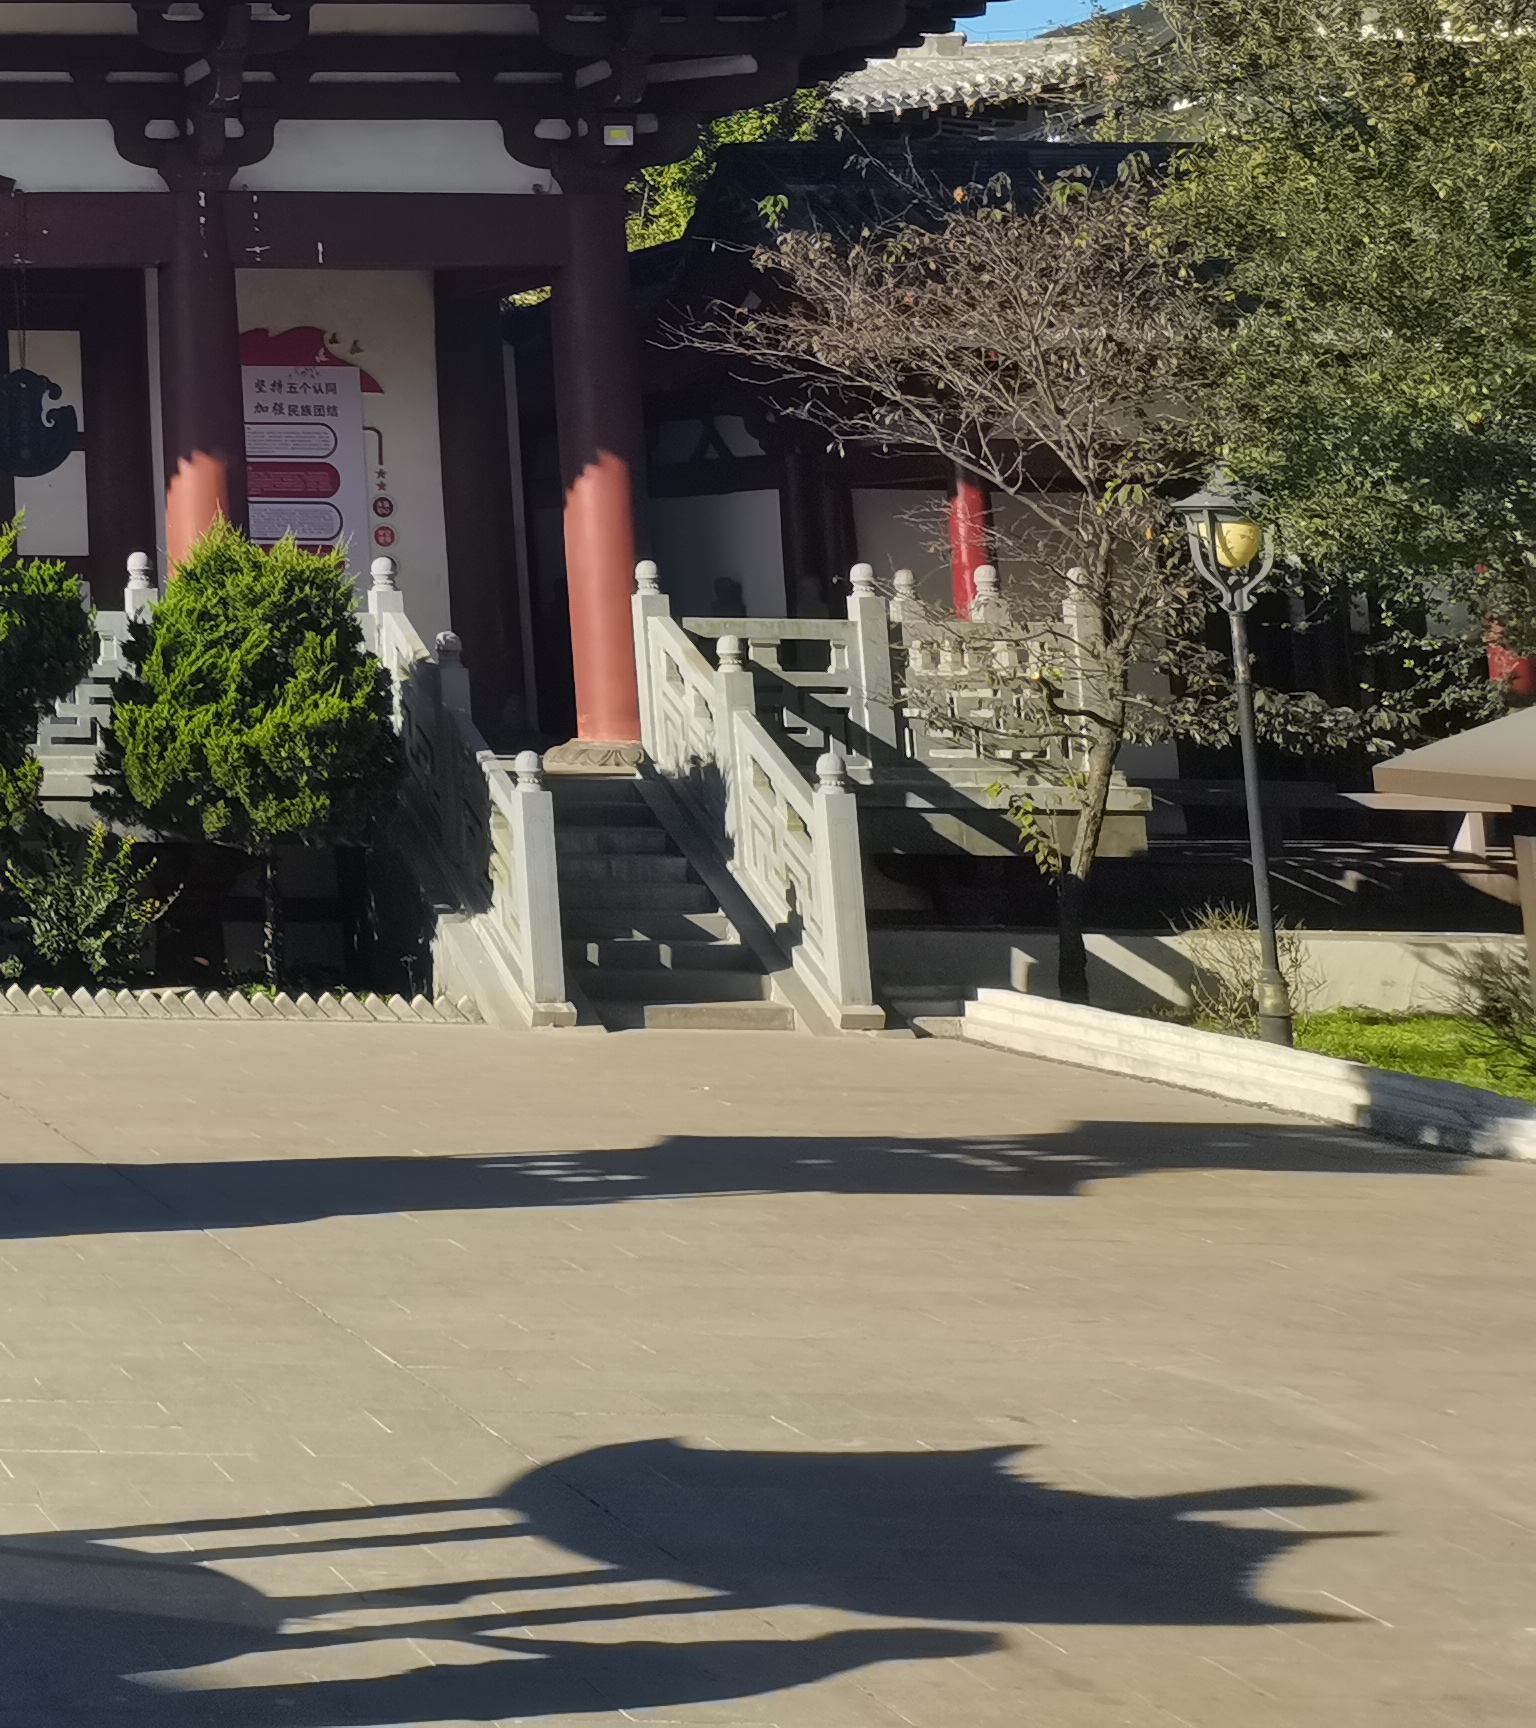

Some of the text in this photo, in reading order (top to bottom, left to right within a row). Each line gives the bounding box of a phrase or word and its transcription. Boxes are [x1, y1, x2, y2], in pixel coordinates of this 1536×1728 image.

[254, 379, 337, 395] 坚持五个认同
[253, 402, 338, 417] 加强民族团结
